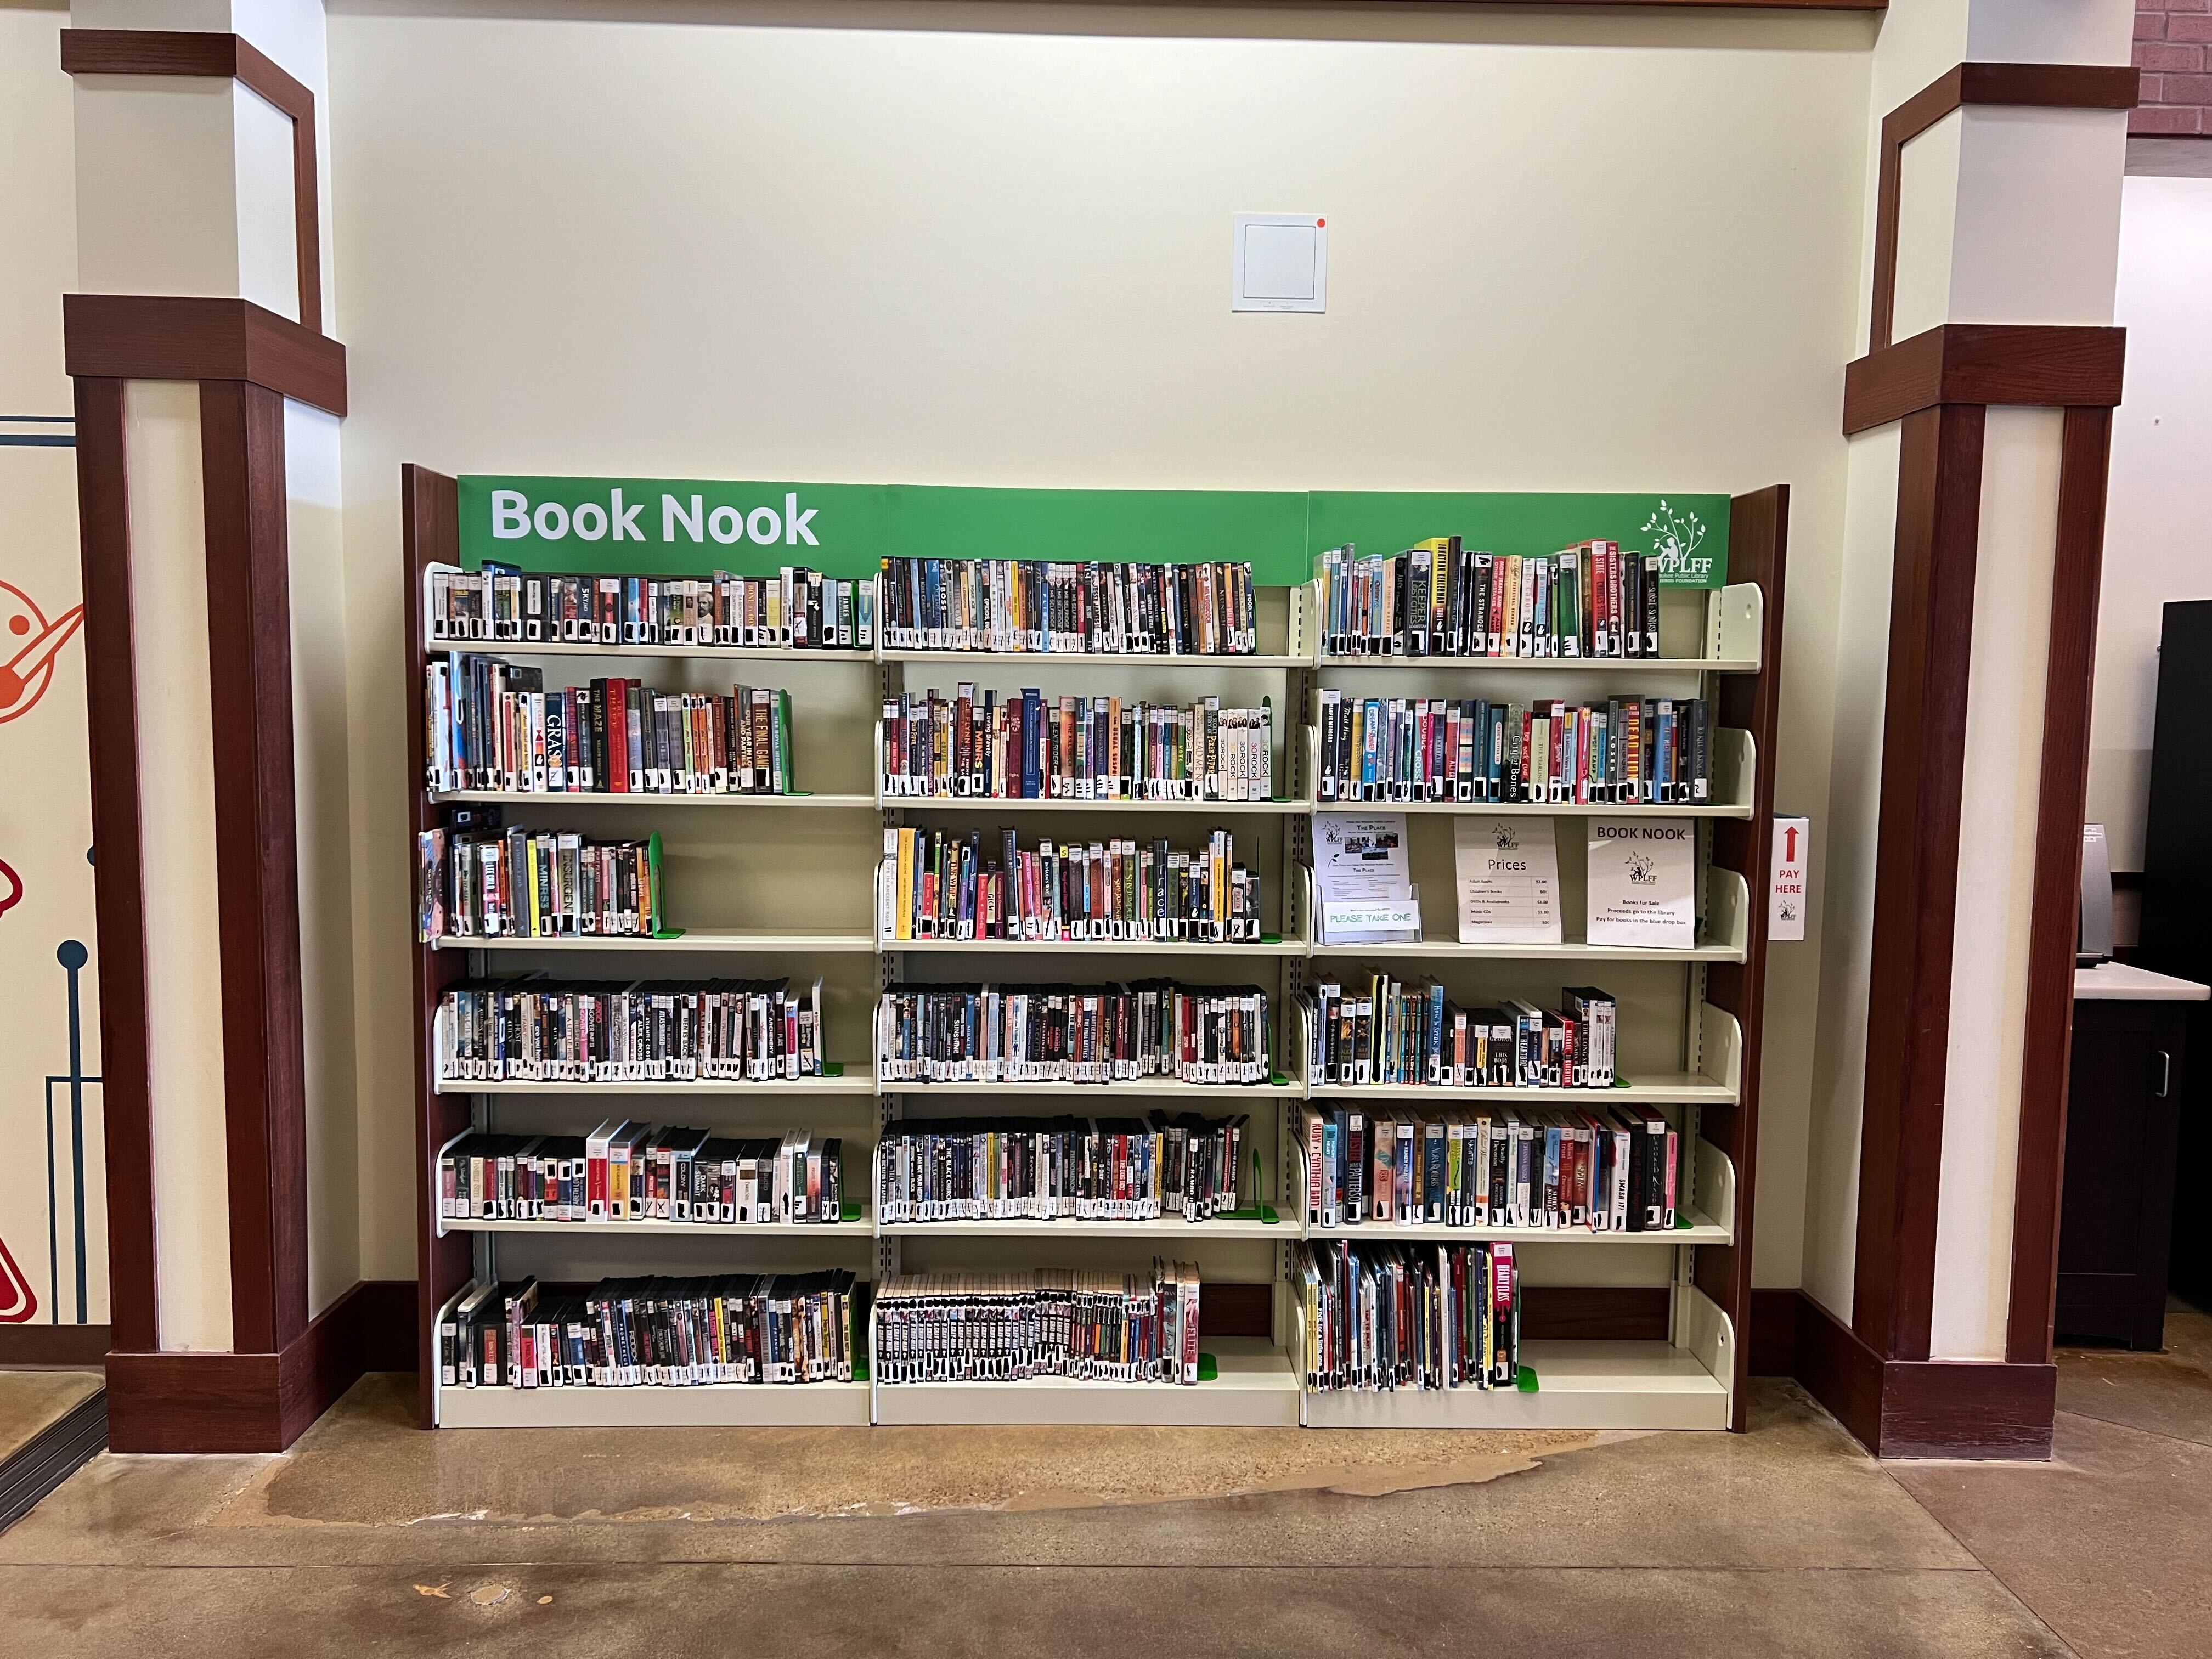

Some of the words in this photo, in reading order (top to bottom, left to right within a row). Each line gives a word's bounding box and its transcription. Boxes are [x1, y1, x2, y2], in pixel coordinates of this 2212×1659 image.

[492, 487, 647, 541] Book
[662, 492, 820, 545] Nook
[1437, 544, 1446, 571] JONATHAN
[1437, 573, 1446, 603] KELLERMAN
[1417, 580, 1426, 622] KEEPER
[755, 708, 767, 723] THE
[756, 725, 768, 747] FINAL
[1207, 735, 1216, 754] Pixie
[1342, 726, 1351, 741] Haig
[1628, 719, 1639, 748] DEAD
[1510, 735, 1520, 757] City
[1207, 755, 1216, 774] Piper
[1628, 753, 1638, 780] LION
[1510, 768, 1520, 797] Bones
[1598, 827, 1638, 838] BOOK
[1643, 828, 1685, 840] NOOK
[486, 865, 495, 876] LEE
[1488, 859, 1526, 870] Prices
[1156, 864, 1166, 917] Trace
[1775, 885, 1801, 893] HERE
[1430, 1147, 1440, 1163] NORA
[1430, 1164, 1440, 1187] ROBERTS
[1497, 1265, 1510, 1285] DEADLY
[1497, 1285, 1510, 1302] CLASS
[619, 1323, 628, 1366] PROMETHEUS
[629, 1331, 638, 1362] RIDDICK
[1187, 1328, 1196, 1355] ELITE
